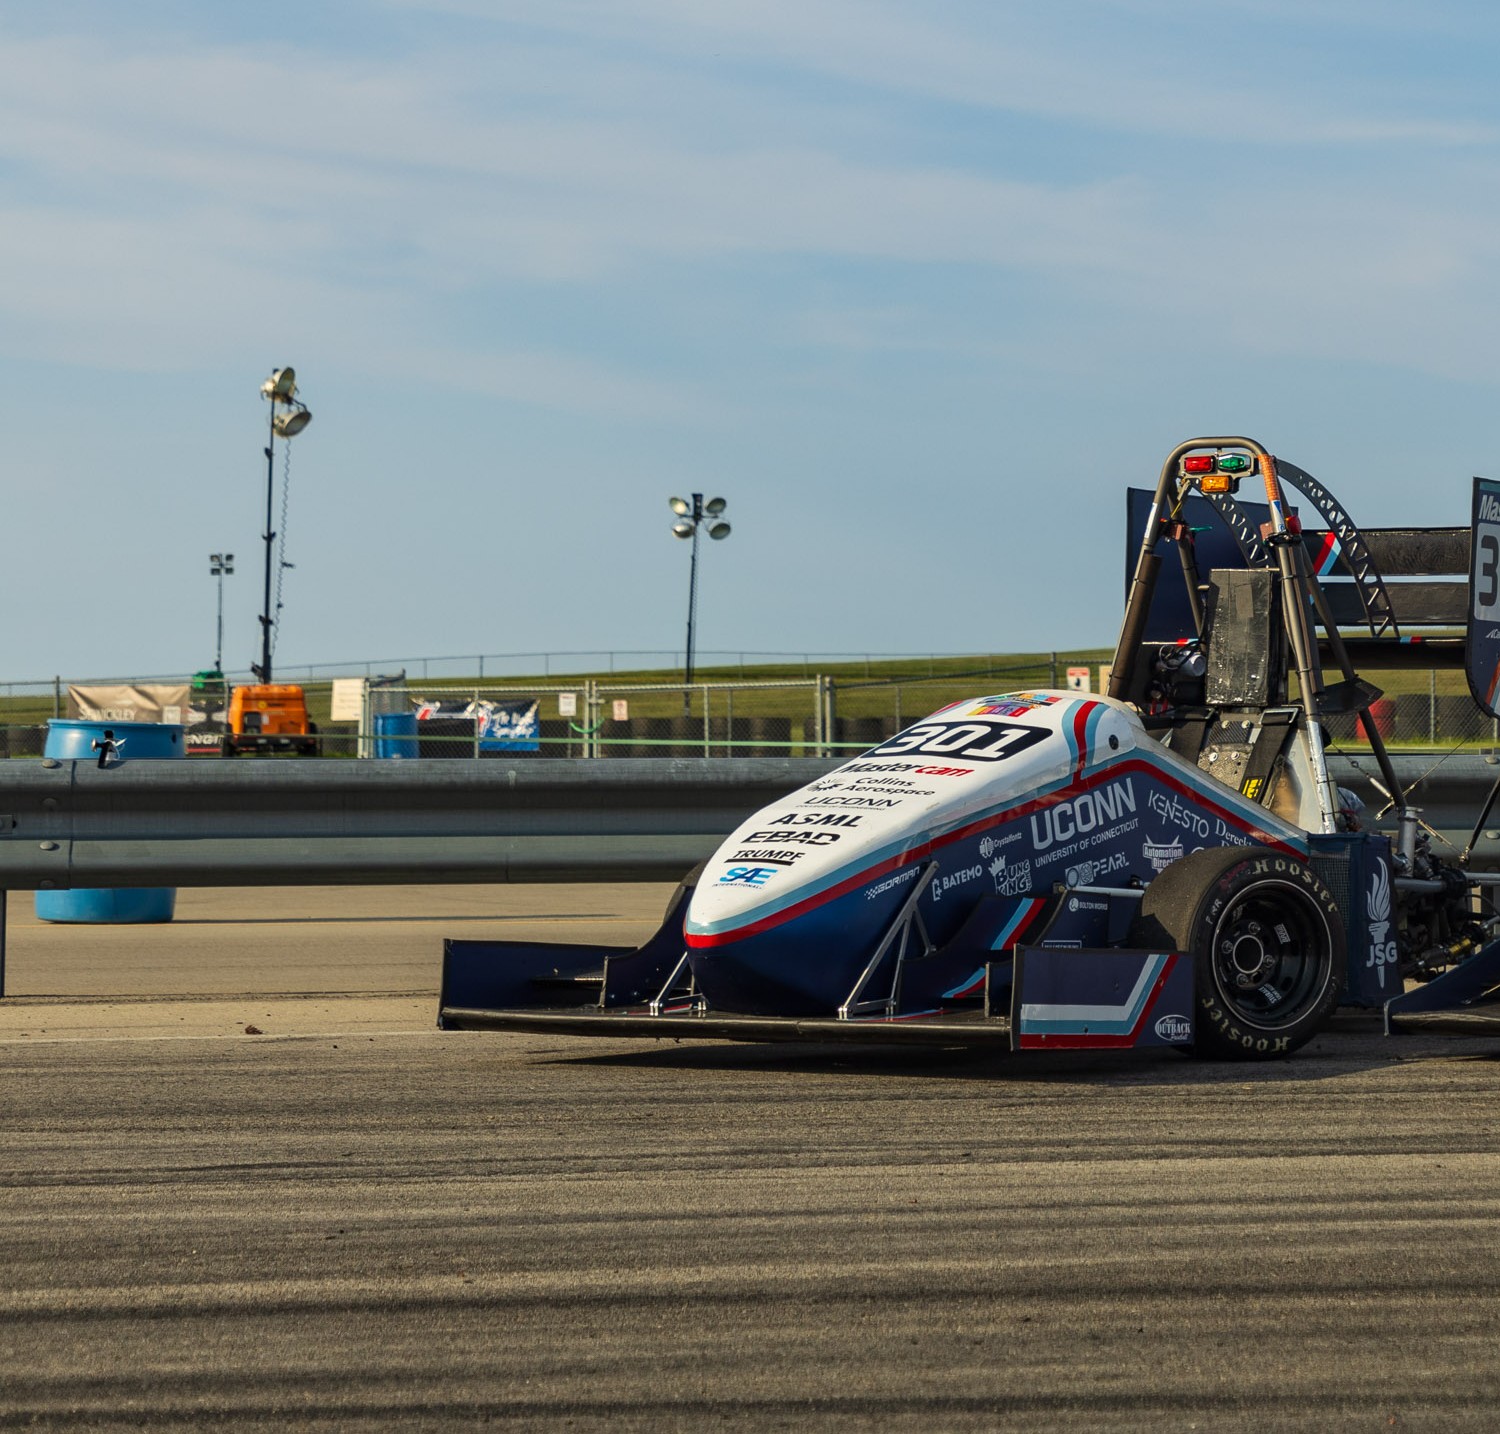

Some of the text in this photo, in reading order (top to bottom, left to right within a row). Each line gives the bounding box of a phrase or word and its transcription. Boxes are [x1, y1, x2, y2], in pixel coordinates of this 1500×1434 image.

[874, 725, 1033, 758] 301
[836, 763, 976, 778] Mastercam
[839, 785, 936, 796] Aerospace
[855, 777, 917, 788] Collins
[803, 796, 904, 808] UCONN
[768, 813, 864, 829] ASML
[1030, 777, 1137, 850] UCONN
[1147, 789, 1210, 838] KENESTO
[740, 831, 842, 846] EBAD
[1034, 818, 1139, 868] UNIVERSITY OF CONNECTICUT
[733, 850, 807, 861] TRUMPF
[1143, 846, 1183, 858] Automation
[719, 867, 779, 885] SAE
[876, 866, 920, 894] GORMAN
[943, 864, 983, 891] BATEMO
[1252, 859, 1338, 913] Hoosier
[1365, 943, 1398, 967] JSG
[1157, 1023, 1191, 1034] OUTBACK
[1202, 997, 1291, 1051] Hoosier
